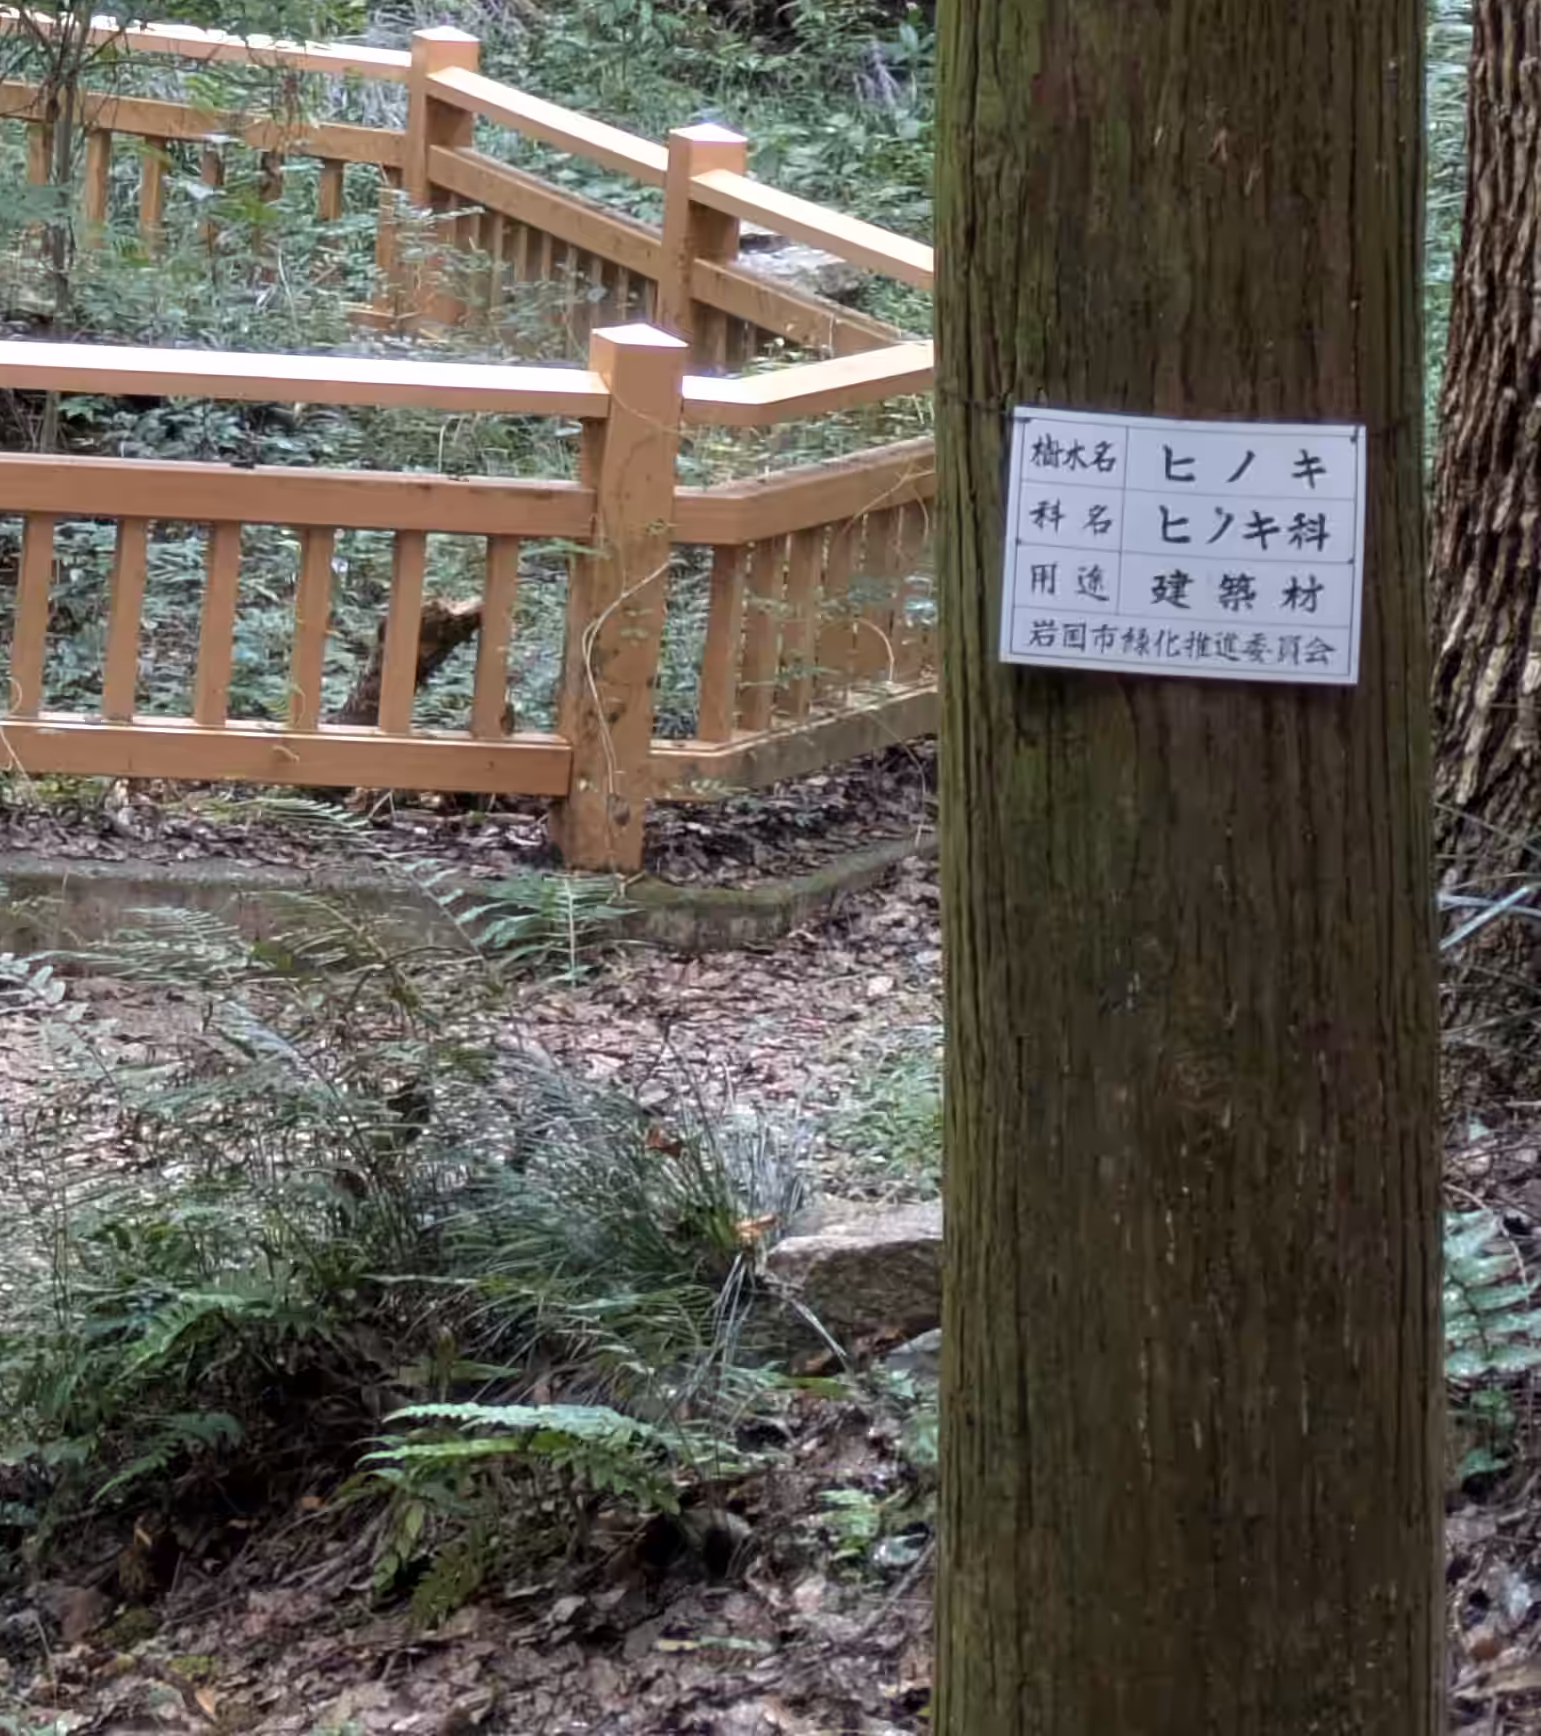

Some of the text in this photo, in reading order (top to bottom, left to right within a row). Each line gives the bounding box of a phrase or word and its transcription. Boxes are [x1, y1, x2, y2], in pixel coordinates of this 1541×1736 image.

[1030, 432, 1117, 472] 樹木名
[1162, 444, 1328, 489] ヒノキ
[1028, 499, 1114, 536] 科名
[1158, 505, 1330, 552] ヒノキ科
[1030, 563, 1110, 602] 用途
[1151, 570, 1325, 613] 建築材
[1028, 619, 1337, 666] 岩国市緑化推進委員会
